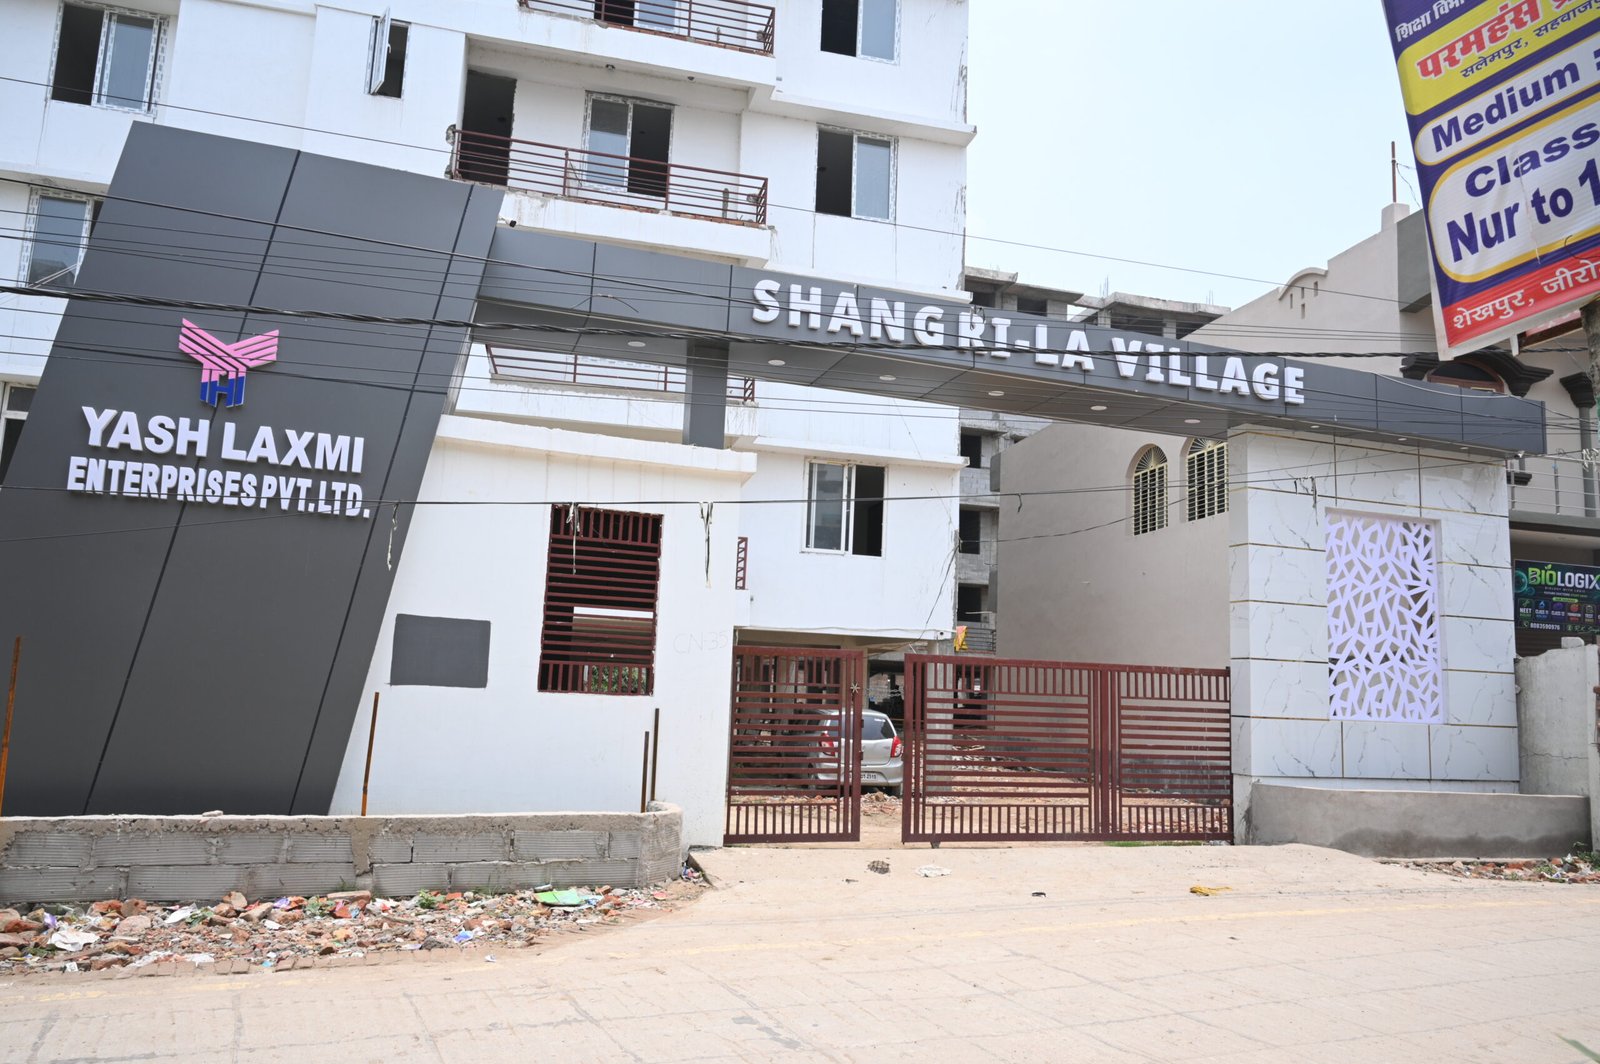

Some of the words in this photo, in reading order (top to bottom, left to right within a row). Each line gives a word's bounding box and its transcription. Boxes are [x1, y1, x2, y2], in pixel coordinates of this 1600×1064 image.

[1431, 61, 1581, 153] Medium
[1464, 121, 1600, 198] Class
[1446, 201, 1520, 264] Nur
[1531, 186, 1574, 226] to
[1541, 258, 1600, 294] जीरो
[751, 277, 1095, 373] SHANGRI-LA
[1111, 335, 1306, 406] VILLAGE
[81, 405, 211, 459] YASH
[220, 421, 365, 475] LAXMI
[66, 455, 258, 509] ENTERPRISES
[1527, 566, 1600, 590] BIOLOGIX
